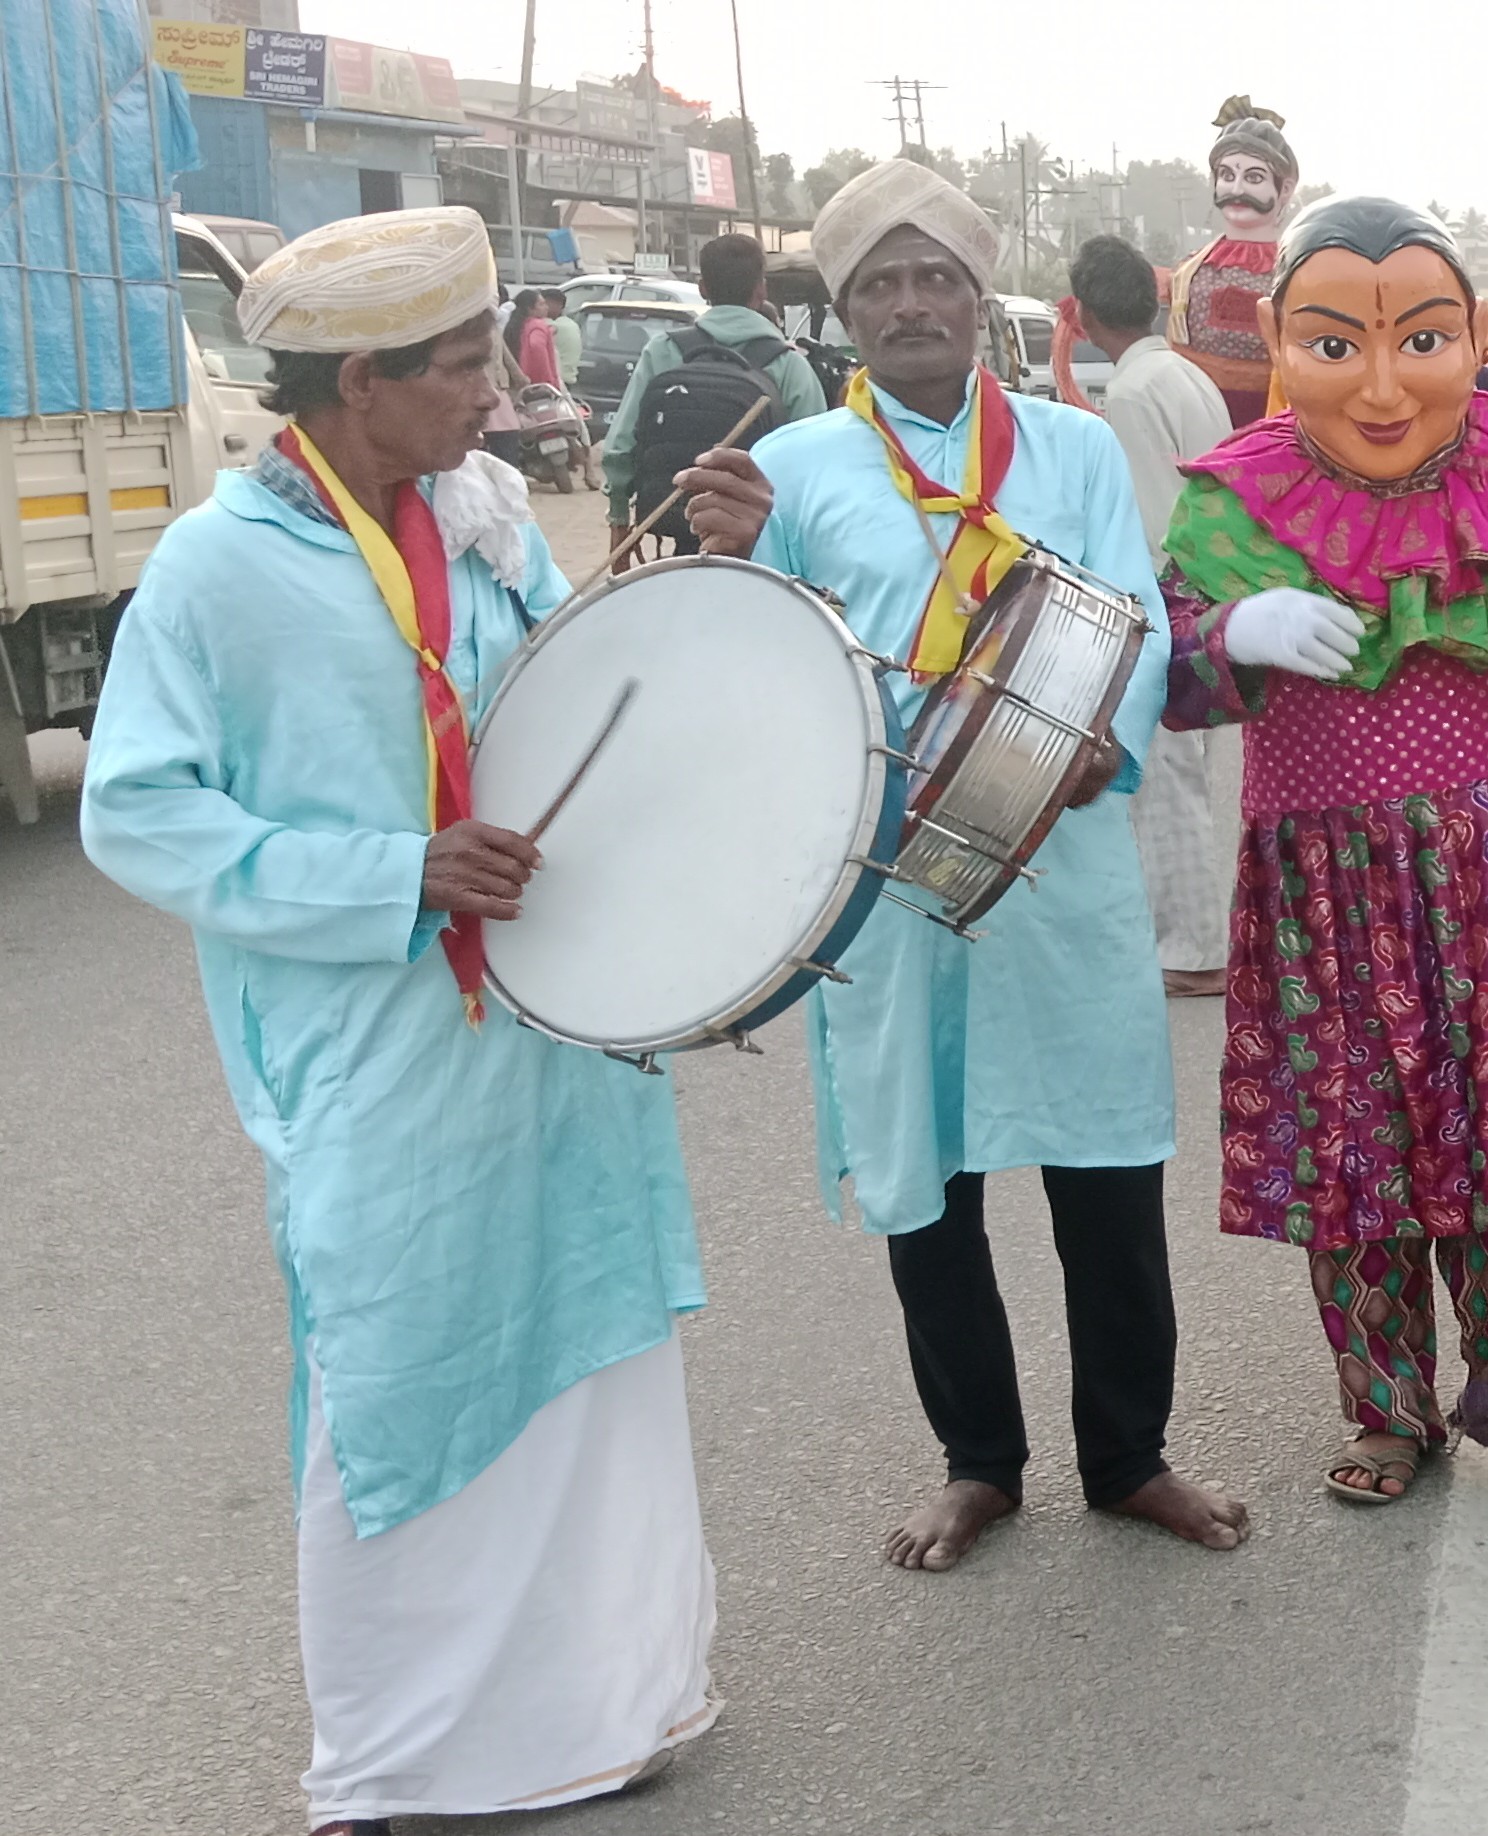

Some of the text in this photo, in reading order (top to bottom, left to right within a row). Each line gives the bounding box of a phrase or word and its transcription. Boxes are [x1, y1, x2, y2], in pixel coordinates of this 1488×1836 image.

[167, 50, 226, 69] Supreme
[249, 70, 266, 81] SRI
[268, 73, 318, 86] HEMAGIRI
[260, 82, 307, 95] TRADERS
